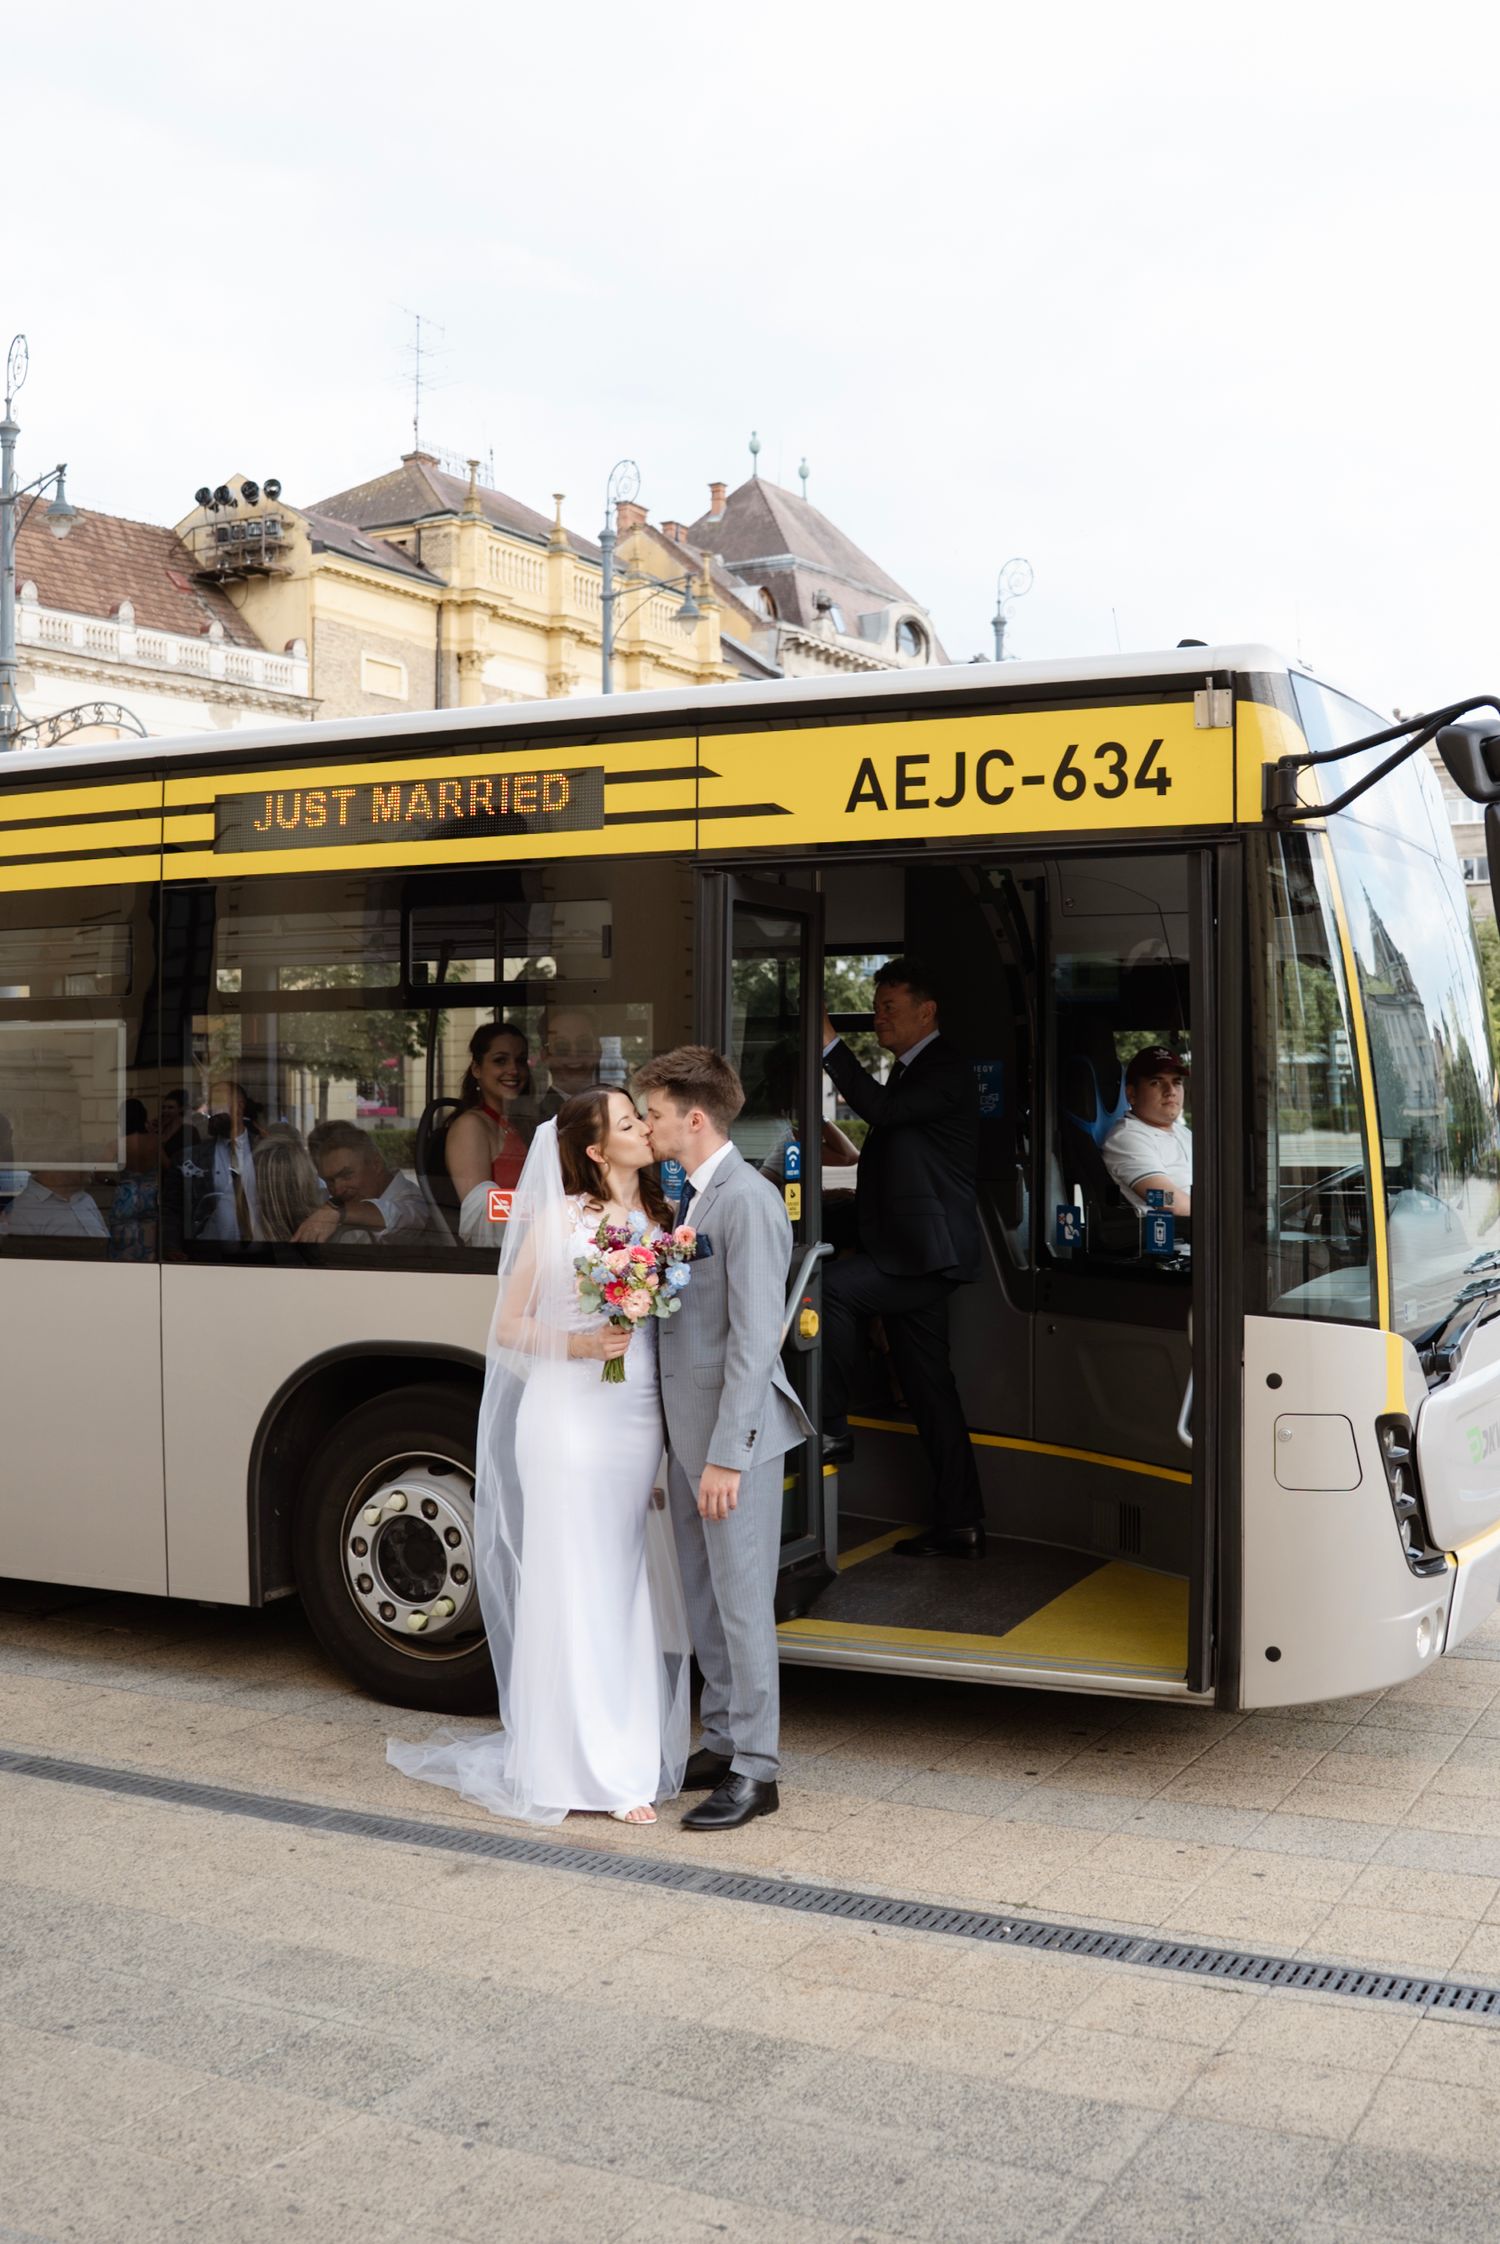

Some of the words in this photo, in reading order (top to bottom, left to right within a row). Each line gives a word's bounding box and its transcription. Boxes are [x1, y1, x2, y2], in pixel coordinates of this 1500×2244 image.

[253, 789, 356, 831] JUST
[371, 773, 570, 823] MARRIED
[844, 738, 1172, 813] AEJC-634
